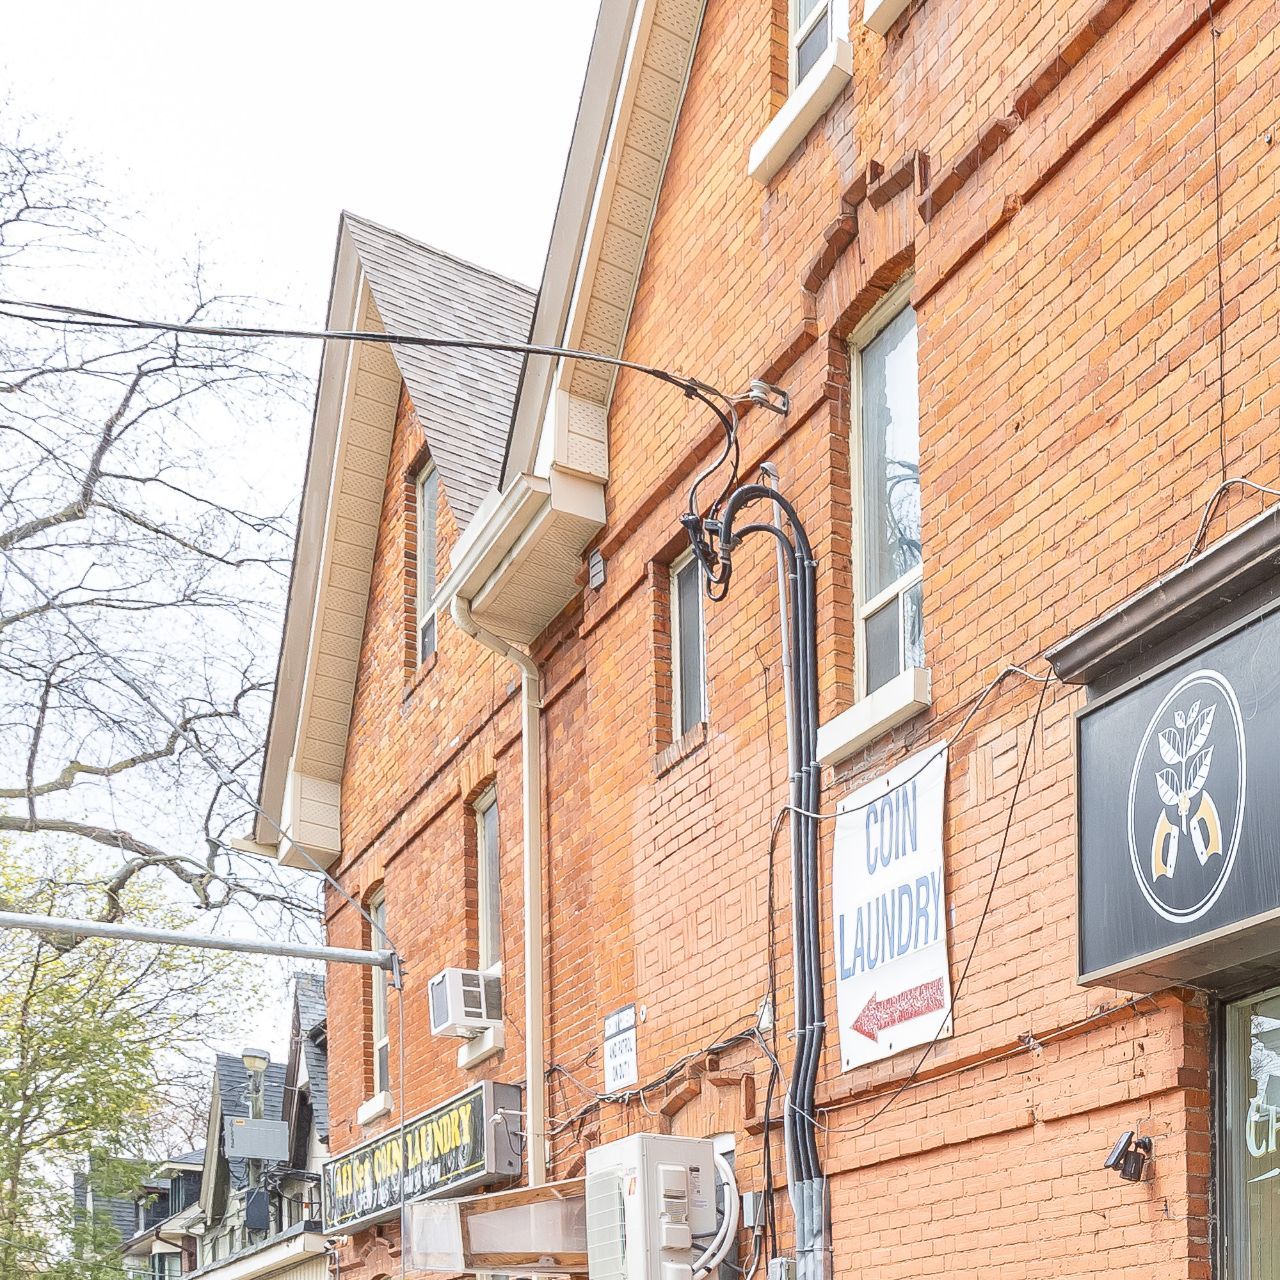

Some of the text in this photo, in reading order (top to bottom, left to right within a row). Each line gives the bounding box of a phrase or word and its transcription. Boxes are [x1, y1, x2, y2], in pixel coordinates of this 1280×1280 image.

[865, 779, 919, 876] COIN
[839, 865, 943, 983] LAUNDRY
[406, 1103, 472, 1170] LAUNDRY
